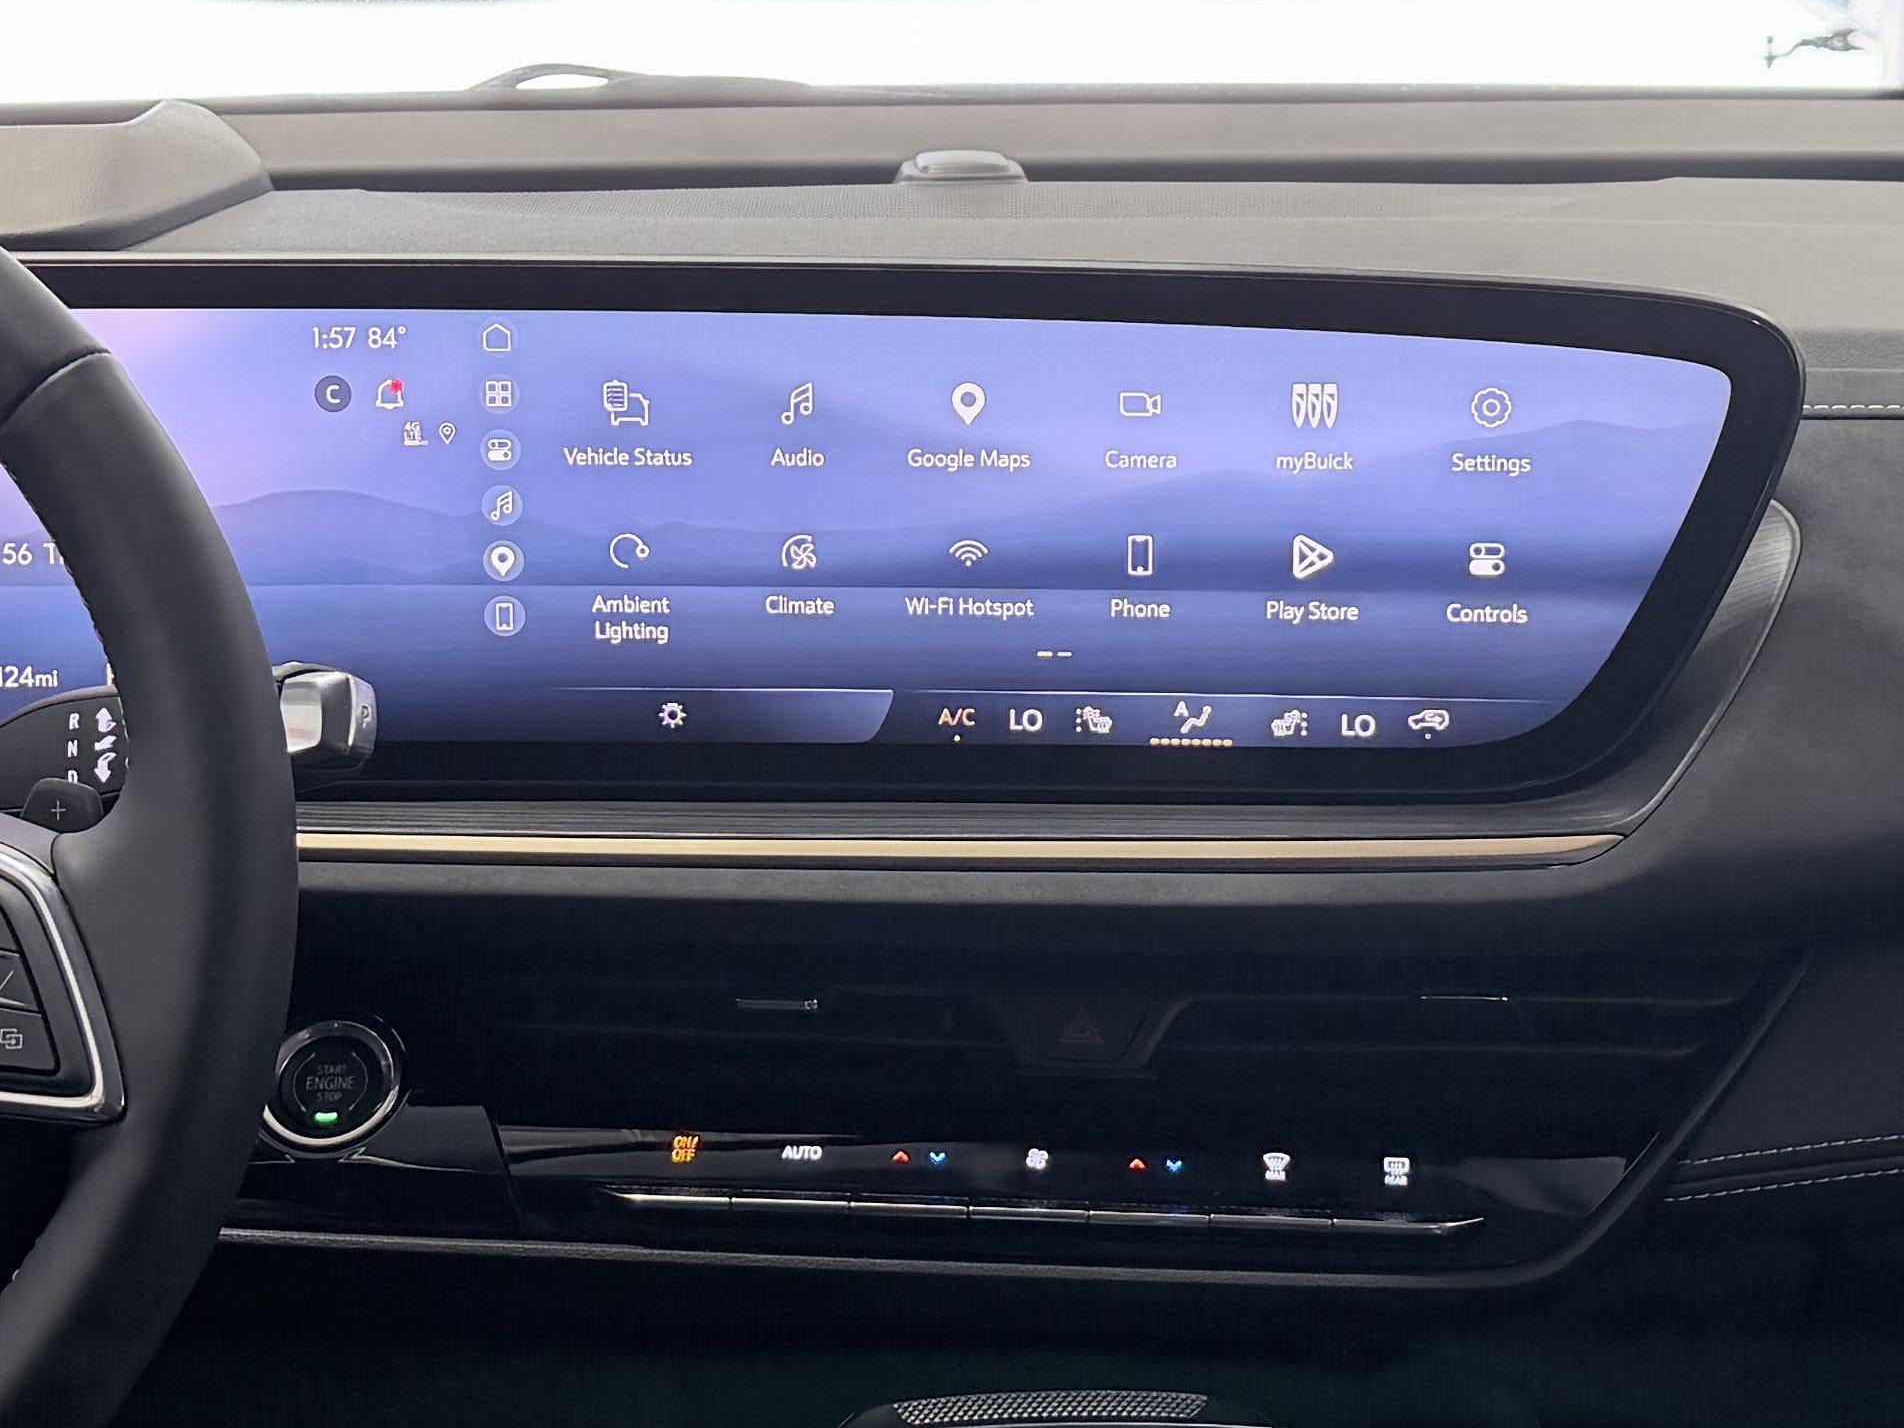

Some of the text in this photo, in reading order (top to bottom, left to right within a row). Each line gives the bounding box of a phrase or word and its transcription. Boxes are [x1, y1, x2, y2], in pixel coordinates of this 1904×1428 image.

[312, 325, 407, 350] 1:57 84°
[325, 384, 341, 404] C
[562, 447, 694, 468] Vehicle Status
[769, 447, 825, 468] Audio
[907, 447, 1031, 472] Google Maps
[1104, 450, 1178, 470] Camera
[1275, 451, 1354, 474] myBuick
[1451, 452, 1532, 477] Settings
[2, 543, 34, 566] 56
[591, 594, 671, 614] Ambient
[765, 595, 836, 615] Climate
[904, 596, 1035, 621] Wi-Fi Hotspot
[1109, 598, 1172, 619] Phone
[1265, 600, 1359, 624] Play Store
[1446, 602, 1529, 624] Controls
[594, 621, 670, 645] Lighting
[68, 712, 80, 730] R
[937, 708, 976, 727] A/C
[1008, 709, 1044, 732] LO
[1341, 713, 1377, 738] LO
[67, 739, 79, 758] N
[306, 1075, 356, 1091] ENGINE
[316, 1091, 343, 1102] STOP
[671, 1148, 697, 1163] OFF
[781, 1145, 823, 1161] AUTO
